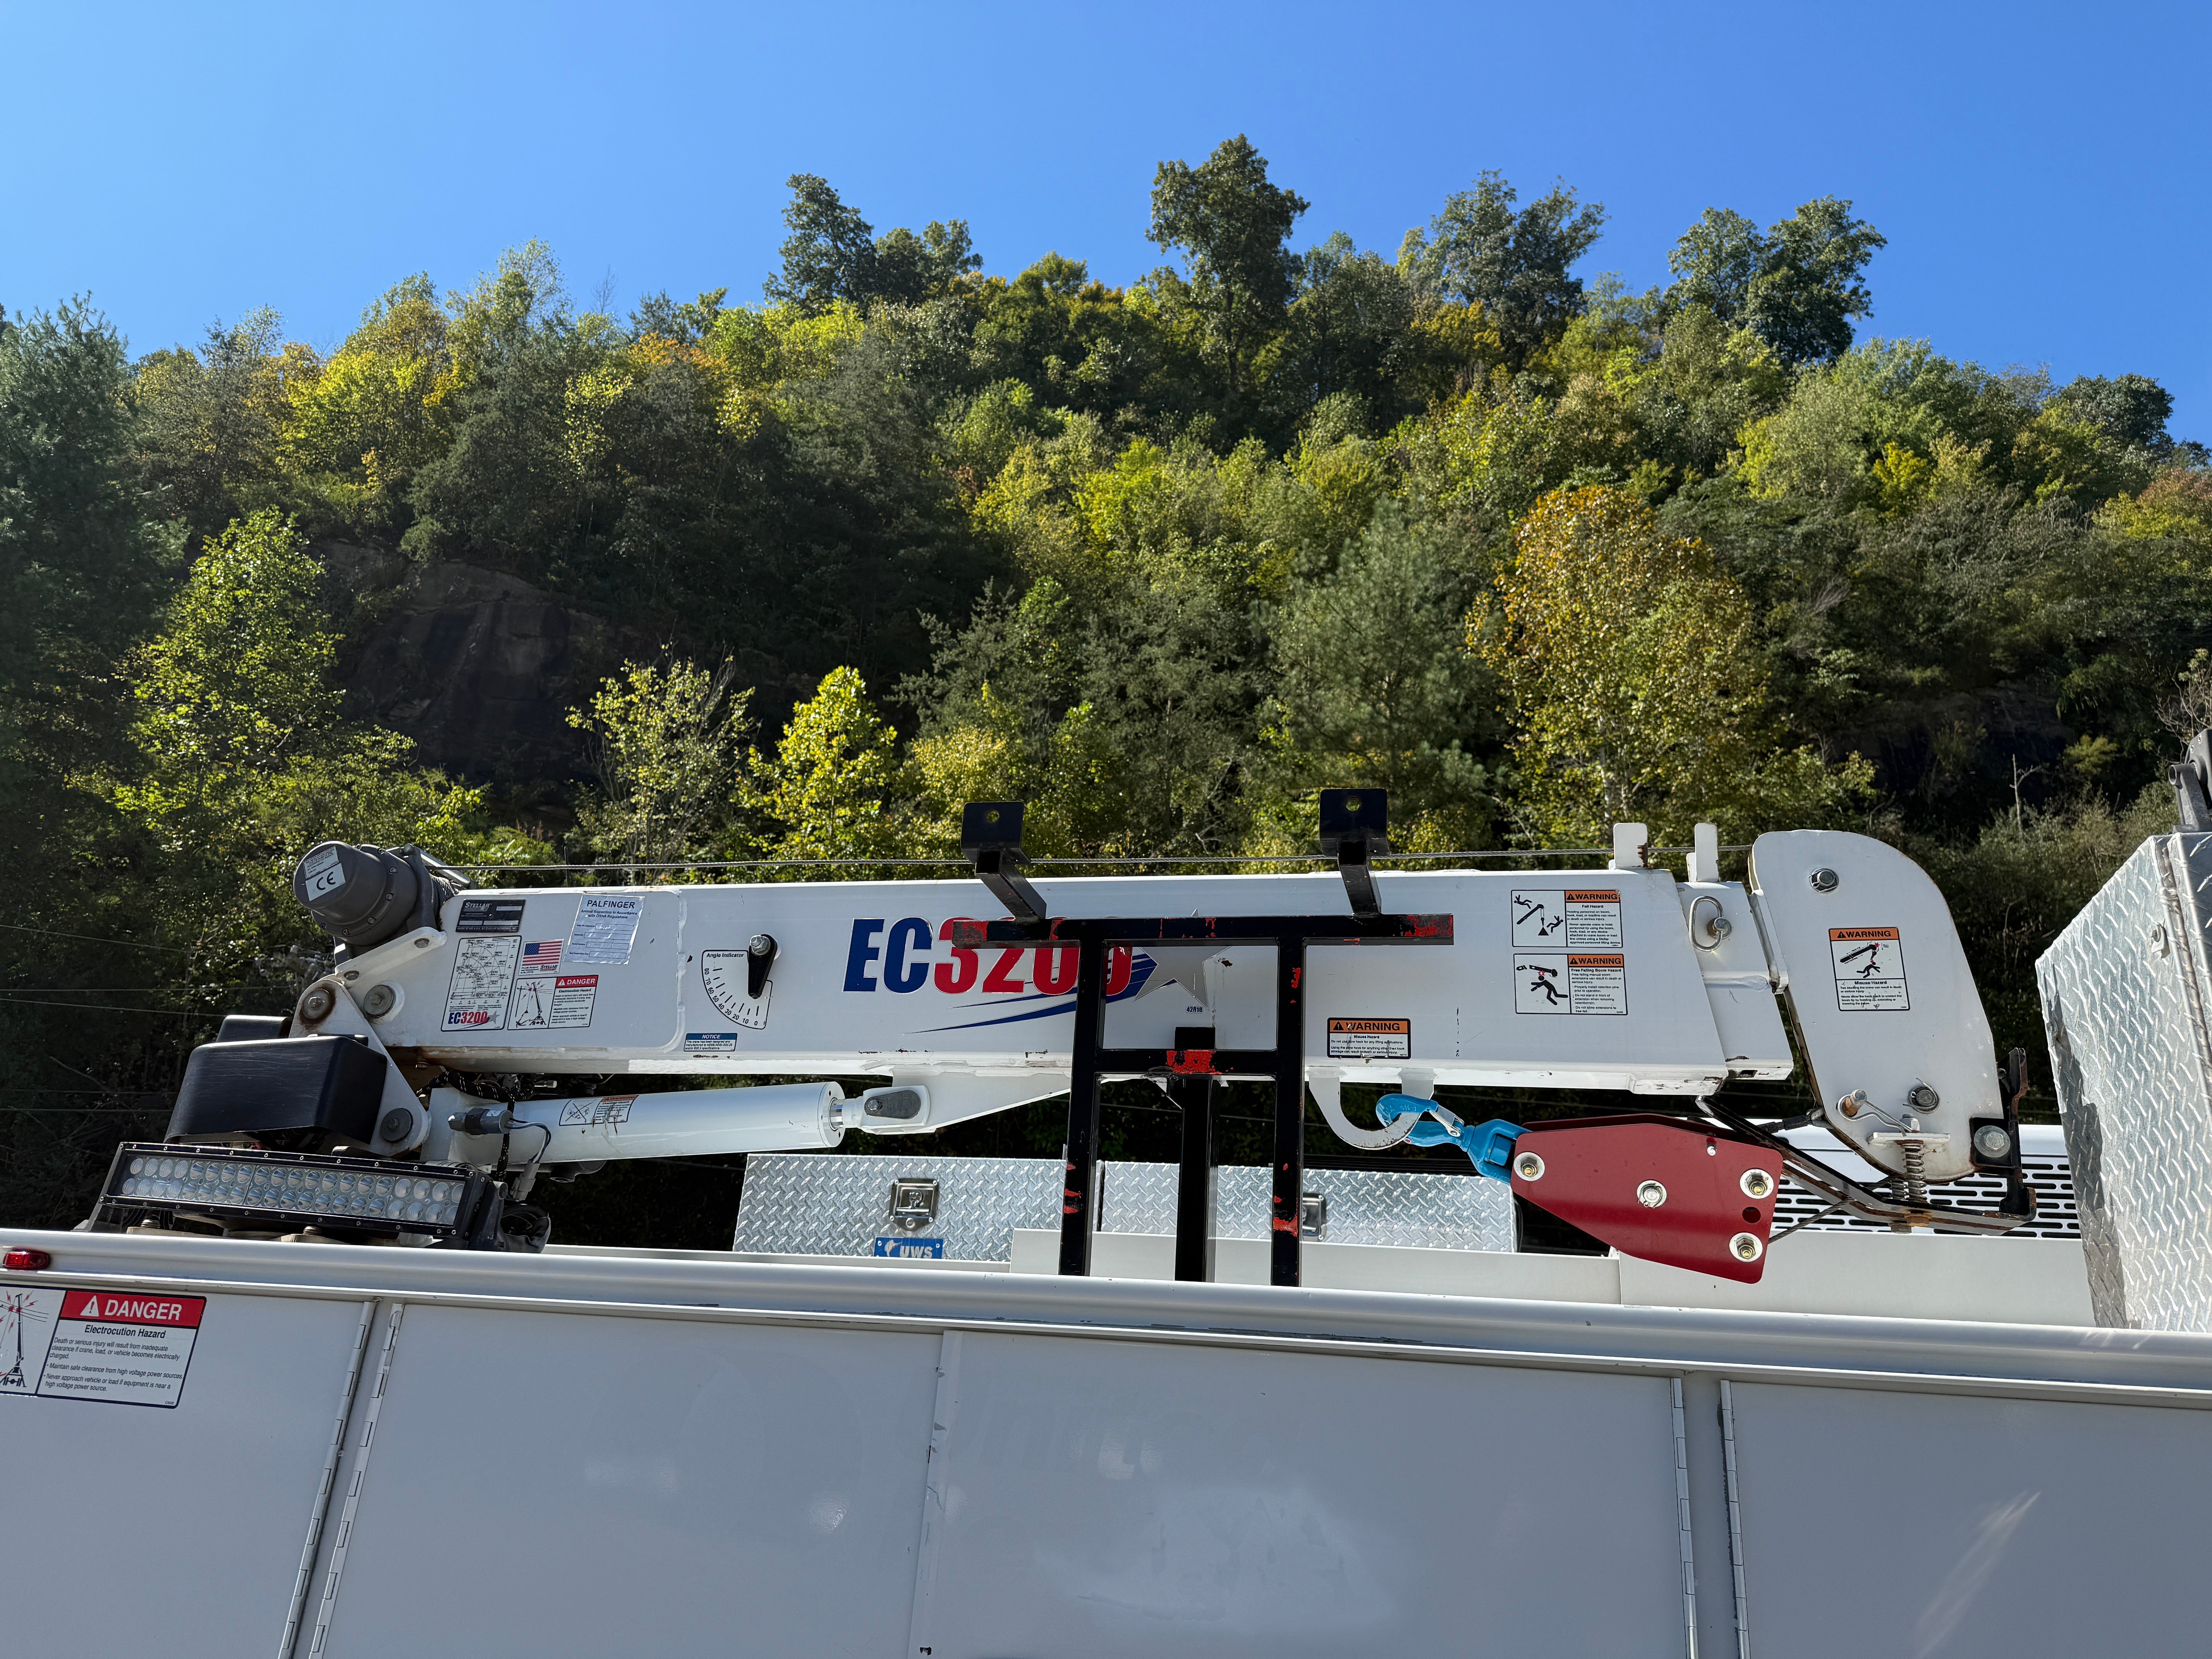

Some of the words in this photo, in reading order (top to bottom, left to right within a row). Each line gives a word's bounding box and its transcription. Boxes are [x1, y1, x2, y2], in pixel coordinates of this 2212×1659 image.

[317, 871, 336, 890] CE
[587, 900, 635, 908] PALFINGER
[448, 1011, 488, 1024] EC3200
[1346, 1022, 1400, 1031] WARNING
[900, 1246, 933, 1258] UWS
[105, 1300, 182, 1321] DANGER
[85, 1324, 136, 1336] Electrocution
[138, 1328, 166, 1338] Hazard
[141, 1344, 168, 1352] inadequate
[155, 1353, 180, 1361] electrically
